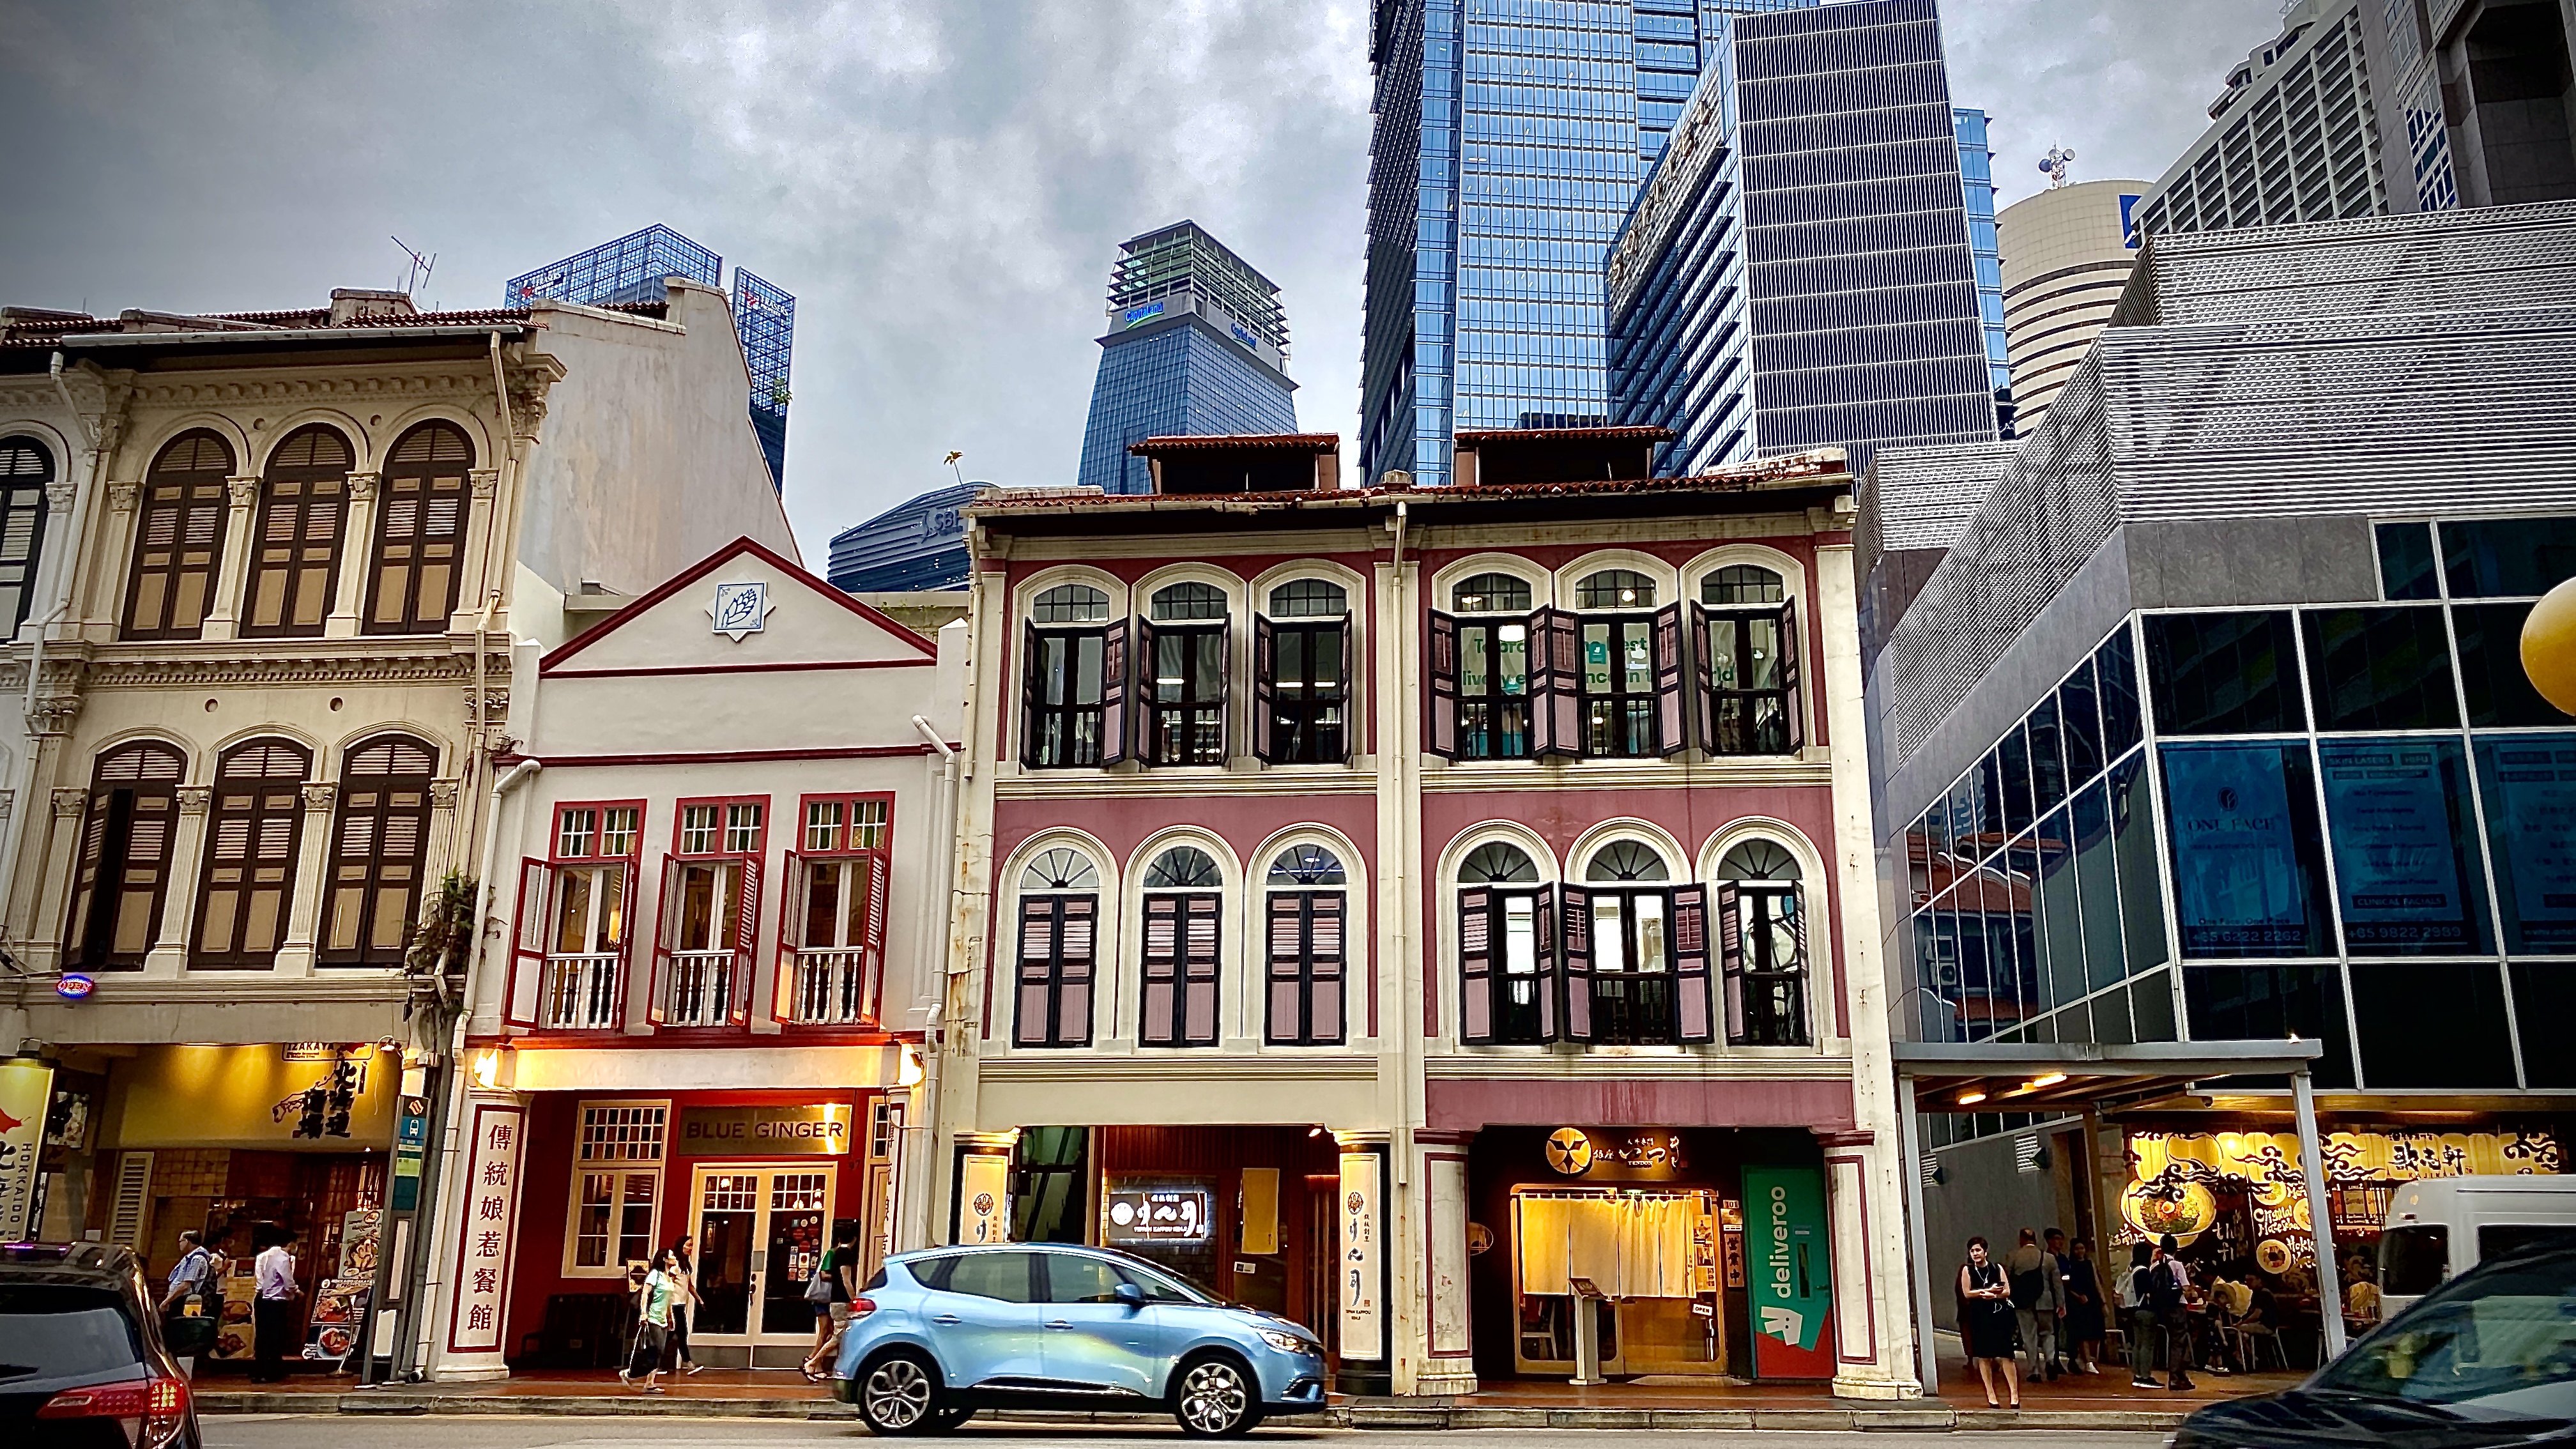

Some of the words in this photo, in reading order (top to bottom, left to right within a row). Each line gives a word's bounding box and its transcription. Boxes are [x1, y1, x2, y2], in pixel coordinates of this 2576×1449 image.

[2358, 898, 2400, 906] CLINICAL
[2403, 897, 2442, 905] FACIALS
[2222, 931, 2260, 942] 6222
[2264, 930, 2301, 942] 2262
[2347, 927, 2375, 939] +65
[2379, 926, 2419, 939] 9822
[57, 981, 92, 991] OPEN
[288, 1043, 335, 1051] IZAKAYA
[686, 1122, 746, 1138] BLUE
[755, 1122, 843, 1138] GINGER
[10, 1143, 33, 1223] HOKKAIDO
[467, 1124, 513, 1331] 傳統娘惹餐館
[1769, 1186, 1791, 1298] deliveroo
